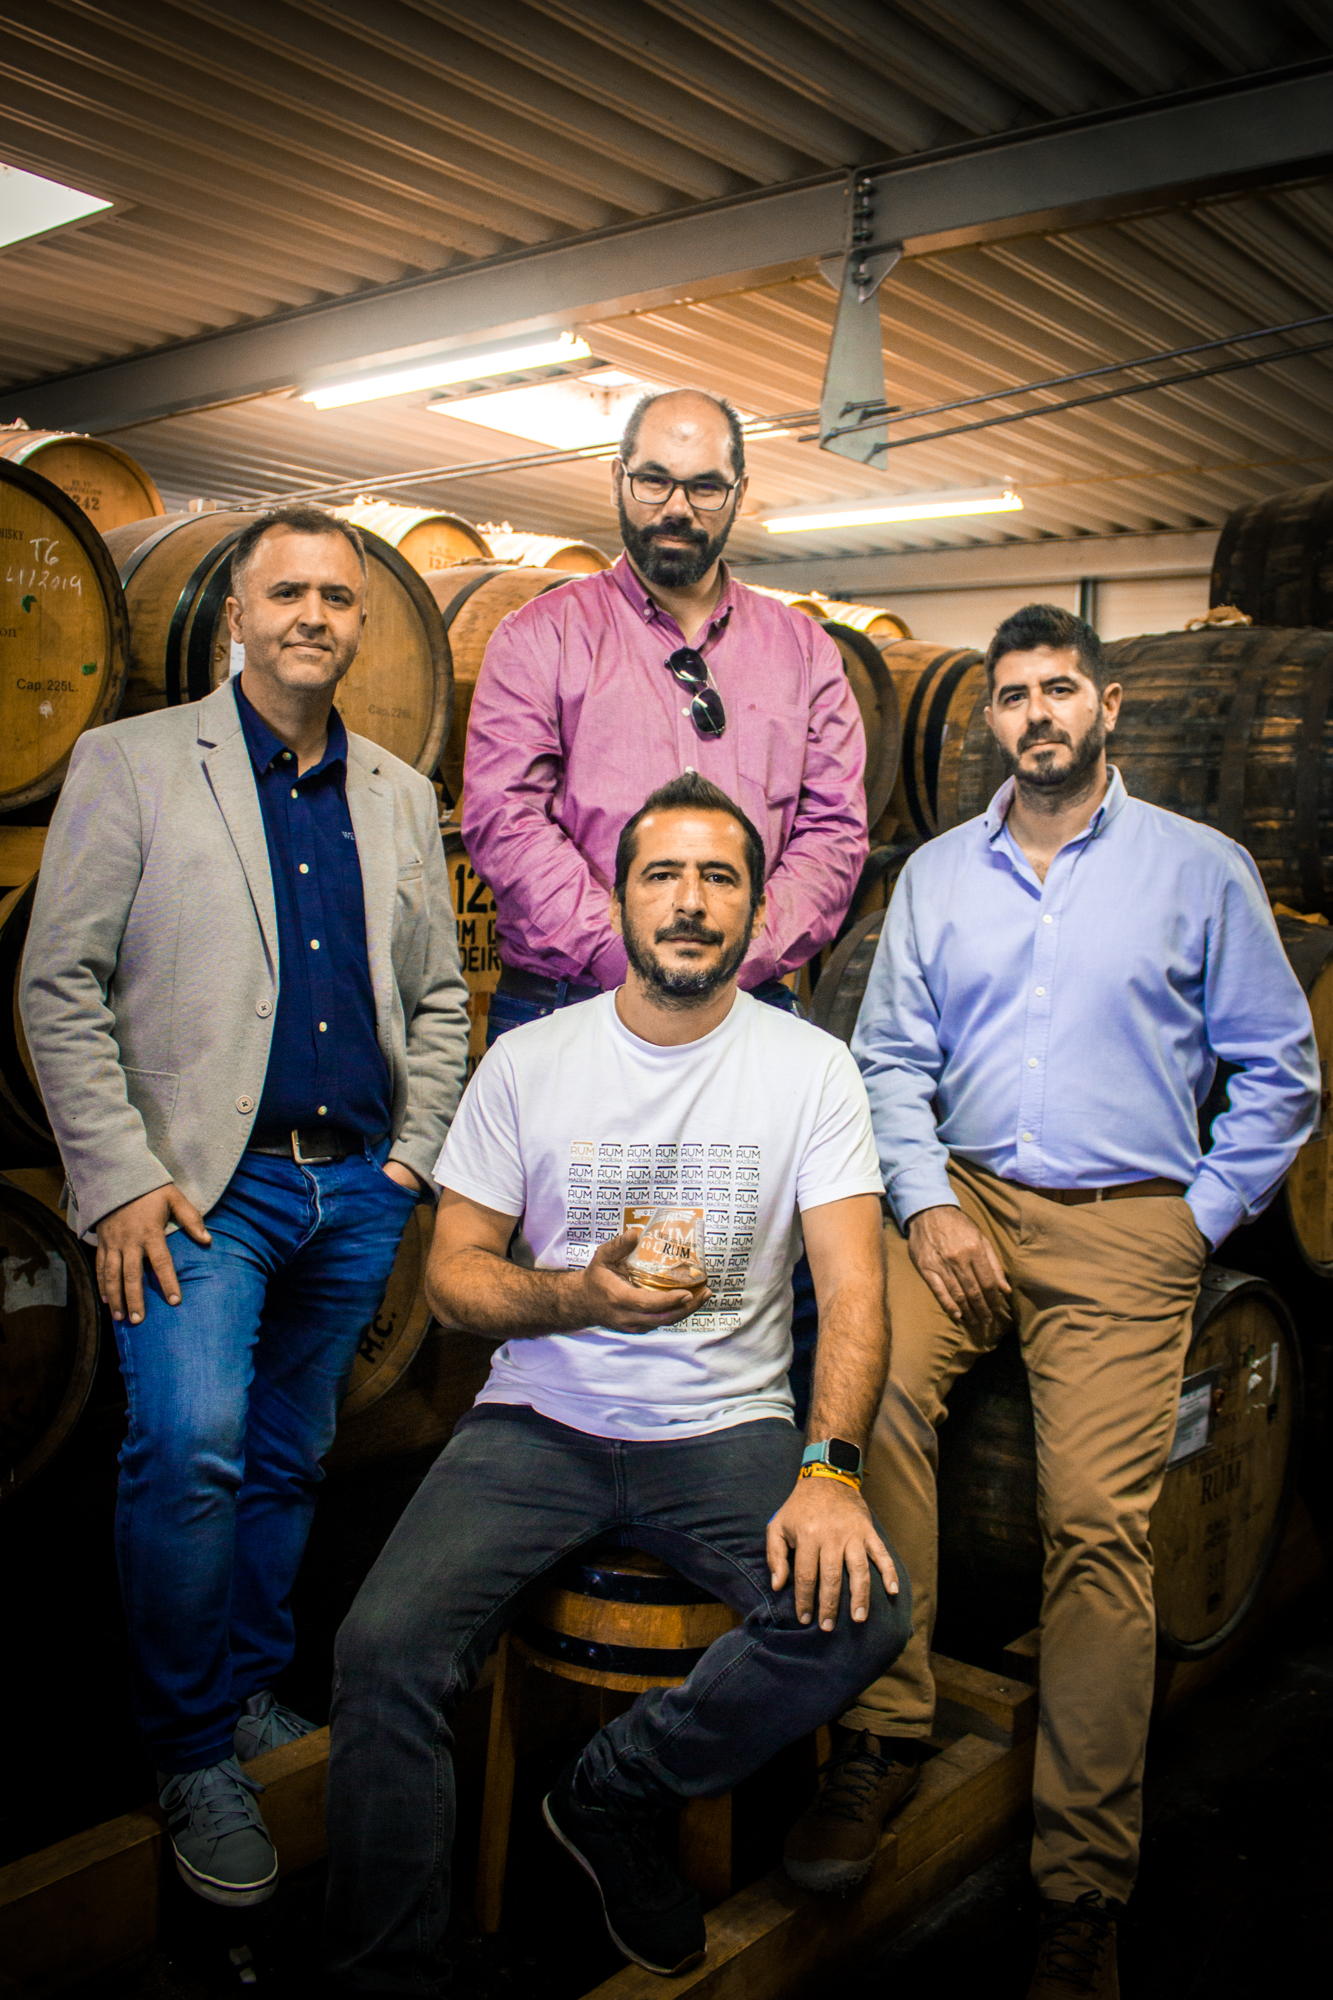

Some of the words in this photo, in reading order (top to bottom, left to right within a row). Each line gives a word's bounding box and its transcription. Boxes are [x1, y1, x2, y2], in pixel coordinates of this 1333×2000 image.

[30, 537, 60, 565] T6
[455, 864, 497, 915] 12
[571, 1146, 595, 1155] RUM
[599, 1148, 623, 1157] RUM
[627, 1149, 651, 1157] RUM
[655, 1149, 678, 1157] RUM
[681, 1148, 704, 1157] RUM
[708, 1149, 732, 1157] RUM
[736, 1150, 760, 1159] RUM
[569, 1168, 593, 1177] RUM
[597, 1169, 622, 1178] RUM
[627, 1170, 651, 1179] RUM
[655, 1170, 678, 1179] RUM
[681, 1170, 703, 1178] RUM
[707, 1170, 731, 1179] RUM
[736, 1172, 759, 1180] RUM
[568, 1190, 592, 1199] RUM
[597, 1191, 621, 1200] RUM
[626, 1191, 650, 1200] RUM
[654, 1191, 678, 1200] RUM
[682, 1192, 703, 1200] RUM
[707, 1192, 730, 1201] RUM
[735, 1194, 759, 1203] RUM
[567, 1211, 591, 1219] RUM
[596, 1212, 620, 1220] RUM
[706, 1214, 729, 1223] RUM
[734, 1216, 756, 1224] RUM
[705, 1236, 728, 1245] RUM
[732, 1237, 753, 1245] RUM
[566, 1247, 589, 1257] RUM
[728, 1258, 749, 1266] RUM
[662, 1242, 691, 1259] RUM
[706, 1278, 720, 1287] UM
[724, 1278, 746, 1286] RUM
[720, 1298, 742, 1306] RUM
[692, 1318, 715, 1326] RUM
[1201, 1459, 1242, 1506] RUM
